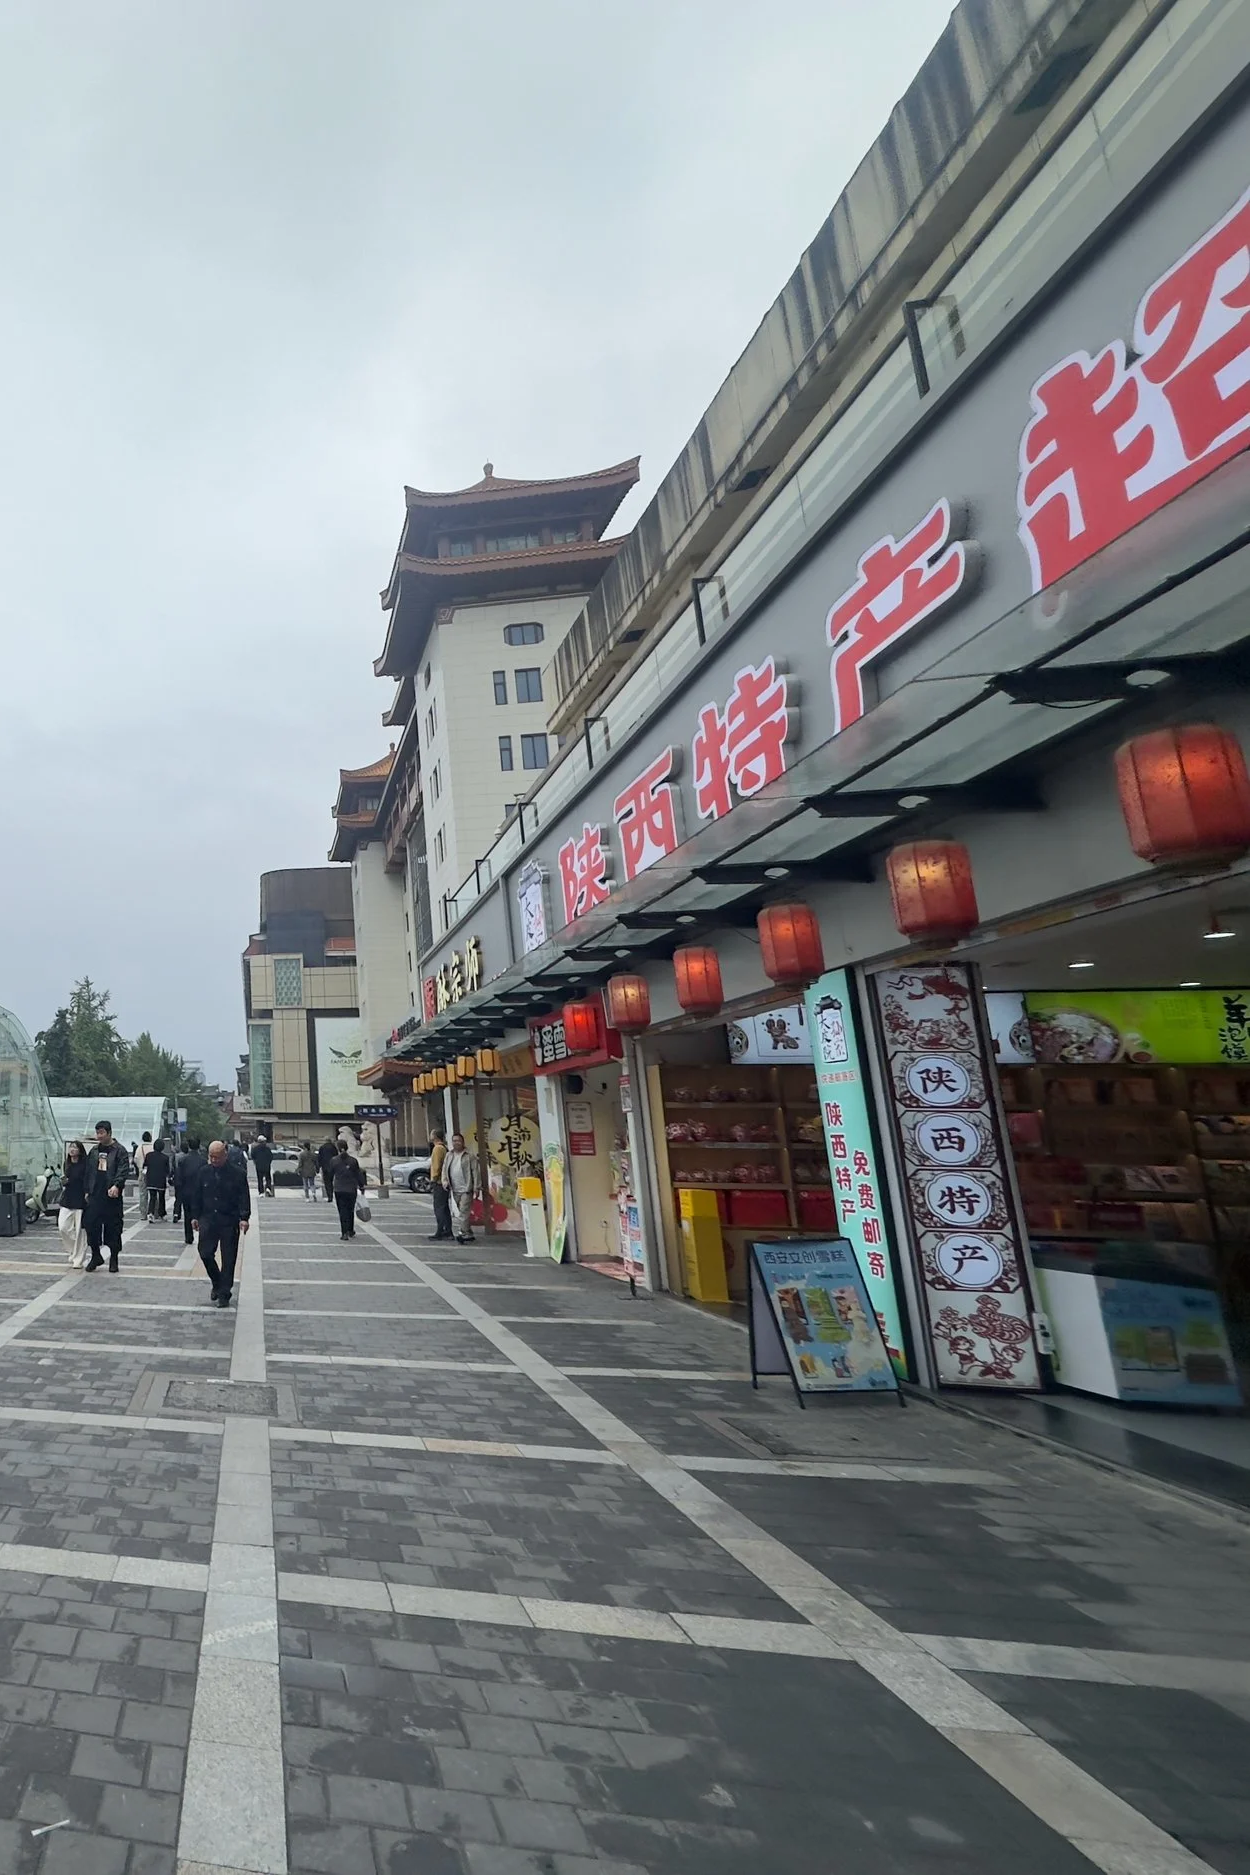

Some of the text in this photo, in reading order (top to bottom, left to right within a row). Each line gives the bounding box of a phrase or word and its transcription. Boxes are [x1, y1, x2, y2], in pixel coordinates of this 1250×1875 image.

[542, 1019, 571, 1063] 蜜雪
[824, 1101, 857, 1225] 陕西特产
[852, 1150, 888, 1281] 免费邮寄
[915, 1066, 990, 1277] 陕西特产
[763, 1251, 847, 1265] 西安文创雪糕
